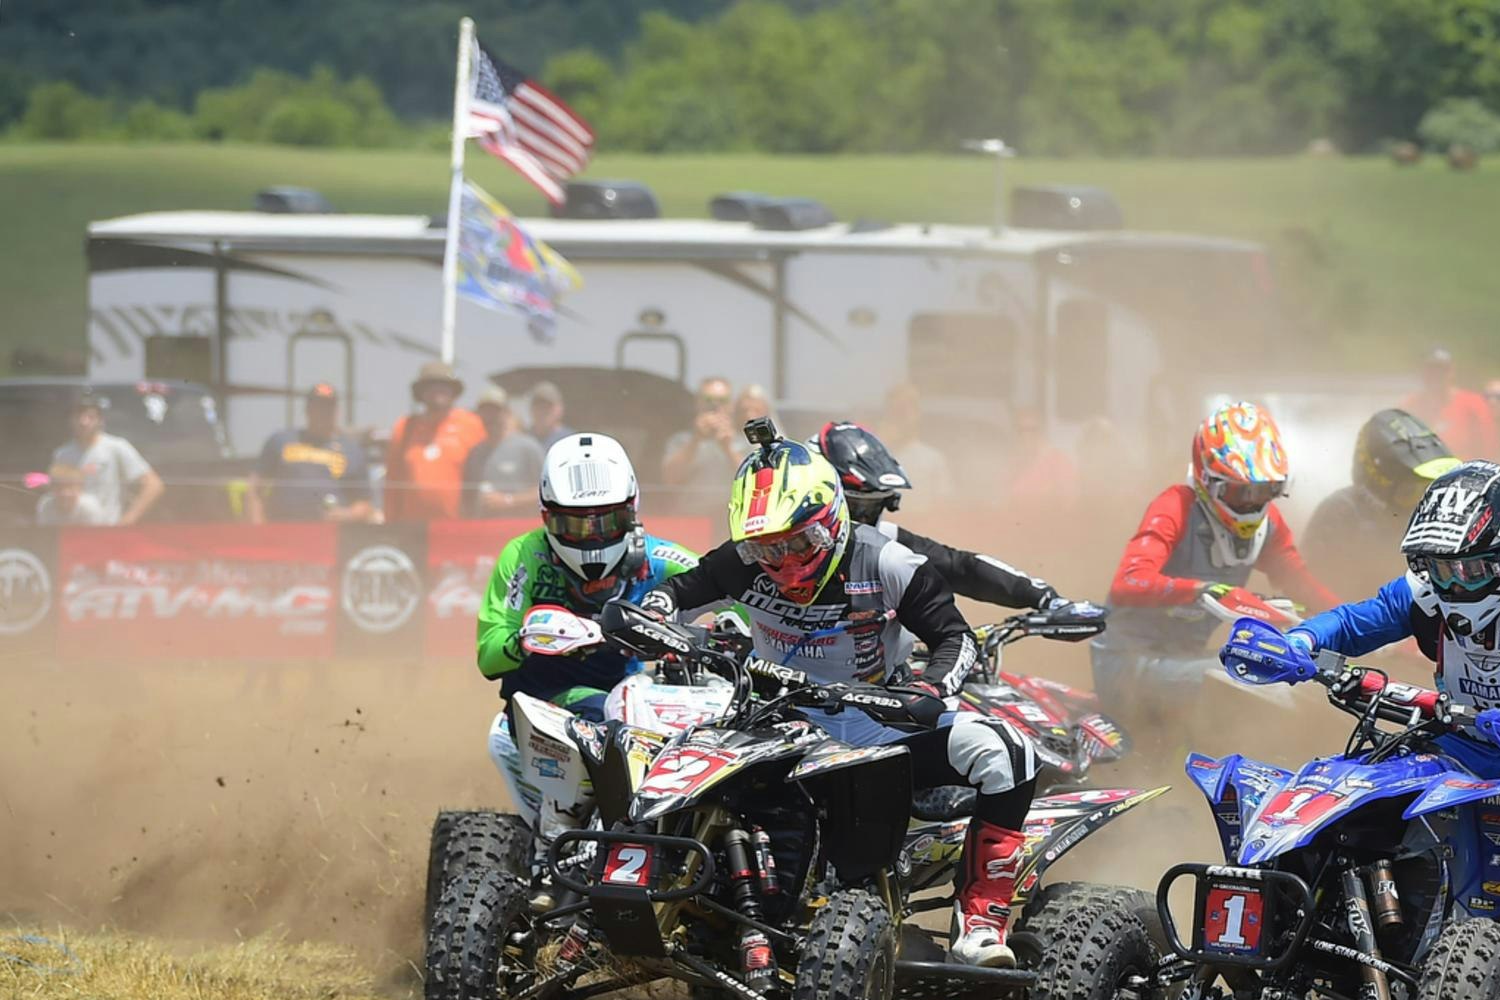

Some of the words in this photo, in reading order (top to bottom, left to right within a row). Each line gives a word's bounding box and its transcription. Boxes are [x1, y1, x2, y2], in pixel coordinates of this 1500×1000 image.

[1424, 484, 1480, 516] FLY
[740, 589, 848, 622] MOOSE
[610, 848, 647, 883] 2
[1218, 895, 1245, 944] 1
[1344, 897, 1370, 942] FOX
[1314, 940, 1335, 953] LONE
[1335, 945, 1357, 960] STAR
[1357, 951, 1390, 972] RACING
